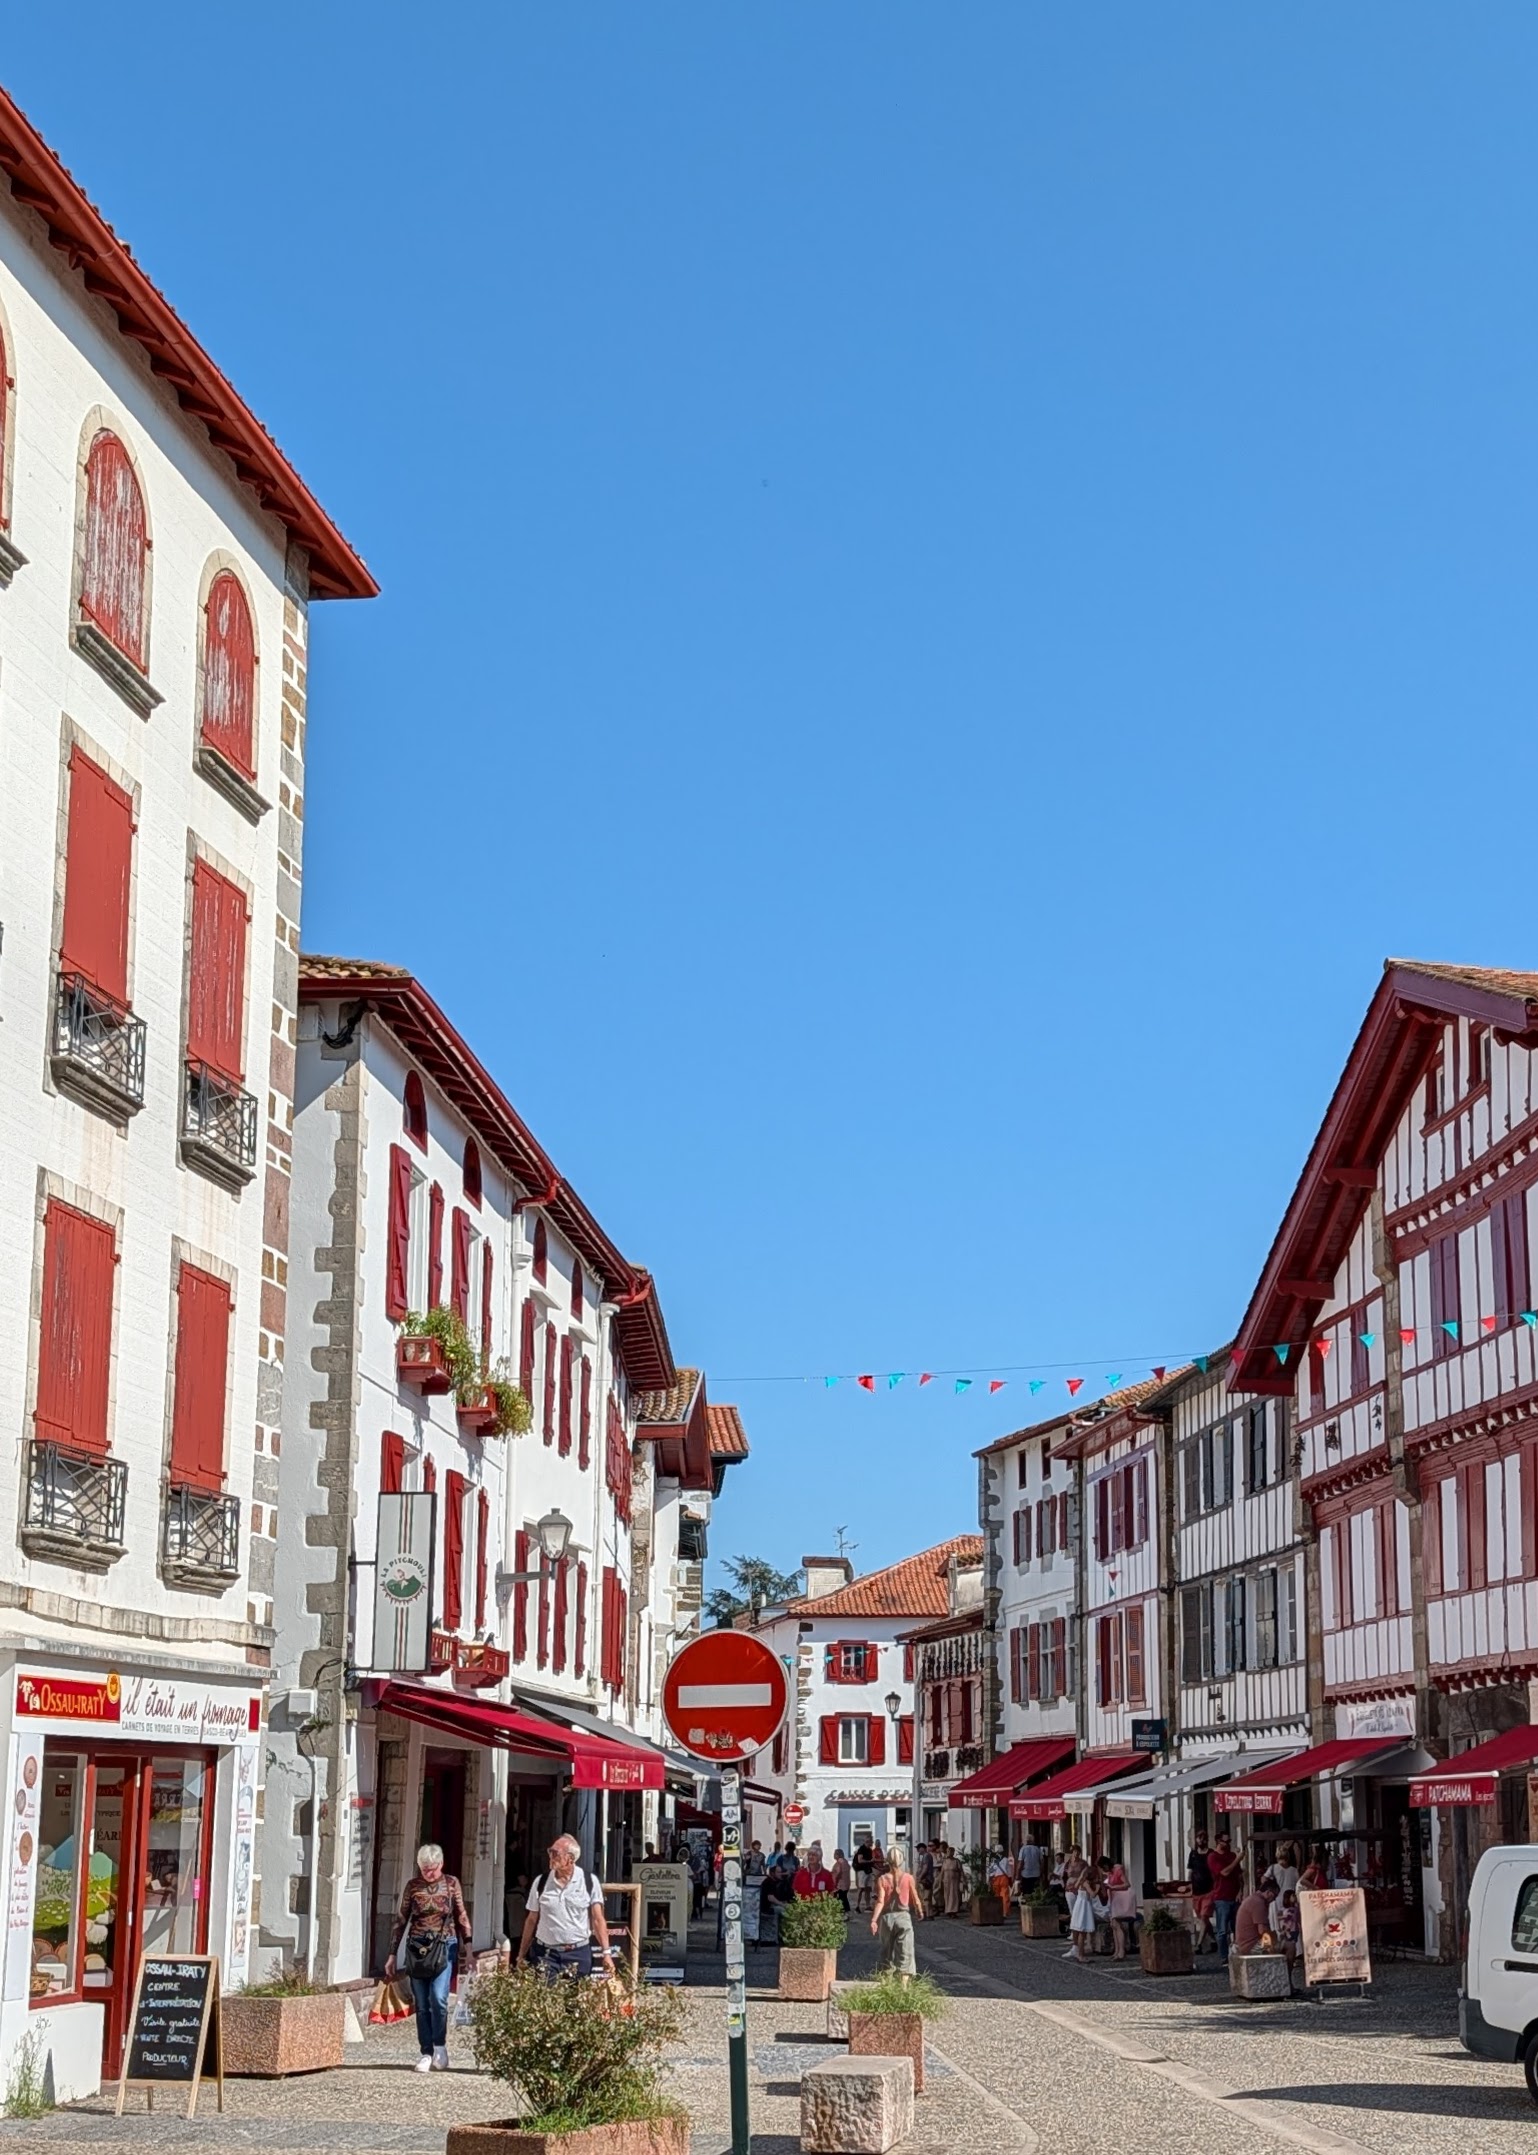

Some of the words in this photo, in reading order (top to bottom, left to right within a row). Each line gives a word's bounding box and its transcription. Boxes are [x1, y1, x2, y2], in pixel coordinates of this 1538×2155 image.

[381, 1568, 389, 1578] LA
[123, 1674, 143, 1715] il
[145, 1681, 174, 1717] était
[177, 1701, 198, 1721] un
[200, 1694, 247, 1743] fromage
[122, 1720, 145, 1731] CARNETS
[146, 1722, 154, 1733] DE
[154, 1723, 173, 1734] VOYAGE
[173, 1724, 180, 1734] EN
[182, 1725, 199, 1735] TERRES
[829, 1789, 875, 1800] CAISSE
[1428, 1783, 1472, 1803] PATCHAMAMA
[1308, 1890, 1355, 1900] PATCHAMAMA
[145, 1963, 207, 1979] OSSAU-IRATY
[147, 1982, 181, 1992] CENTRE
[141, 2015, 167, 2027] Visite
[168, 2016, 200, 2035] gratuite
[142, 2051, 190, 2066] PRODUCTEUR
